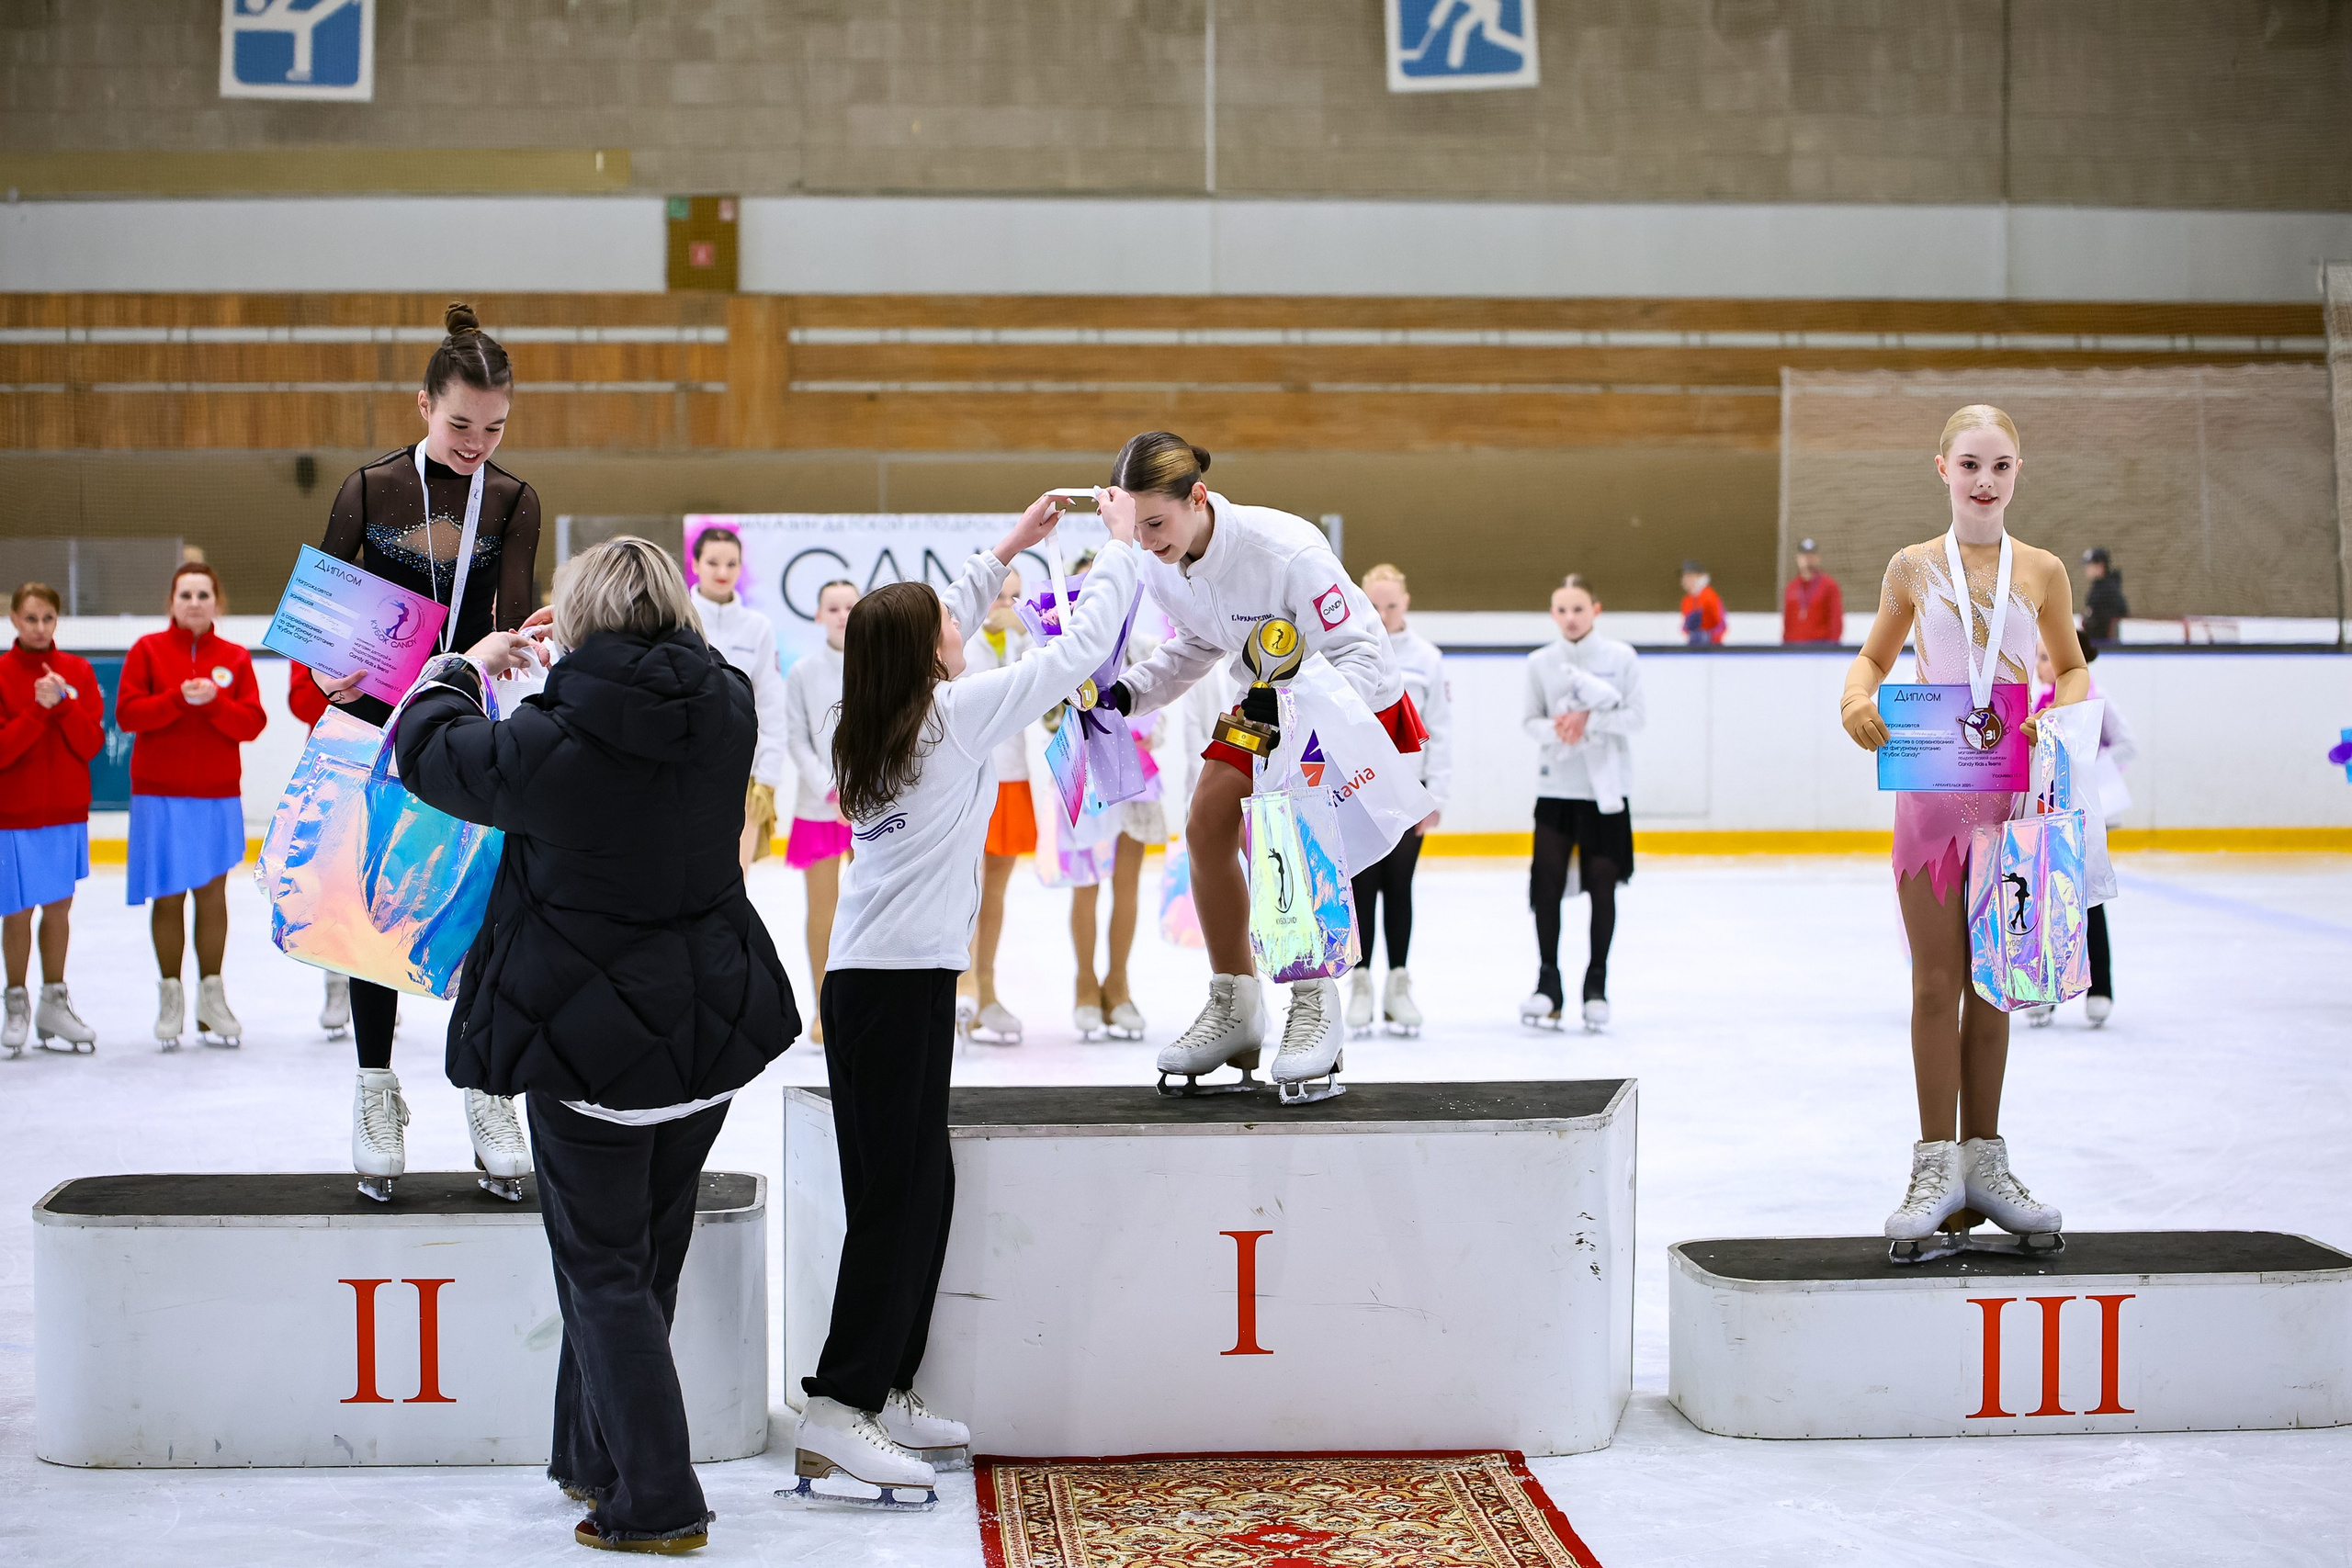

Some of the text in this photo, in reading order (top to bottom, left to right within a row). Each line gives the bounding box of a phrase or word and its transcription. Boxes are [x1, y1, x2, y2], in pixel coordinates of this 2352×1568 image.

[1323, 597, 1342, 616] CANDY
[286, 615, 322, 634] соревнованиях
[286, 622, 313, 638] фигурному
[313, 636, 334, 648] катанию
[370, 619, 417, 649] КУБОК CANDY
[349, 651, 364, 662] Candy
[1219, 1230, 1273, 1355] I
[338, 1279, 457, 1403] II
[1965, 1294, 2136, 1418] III
